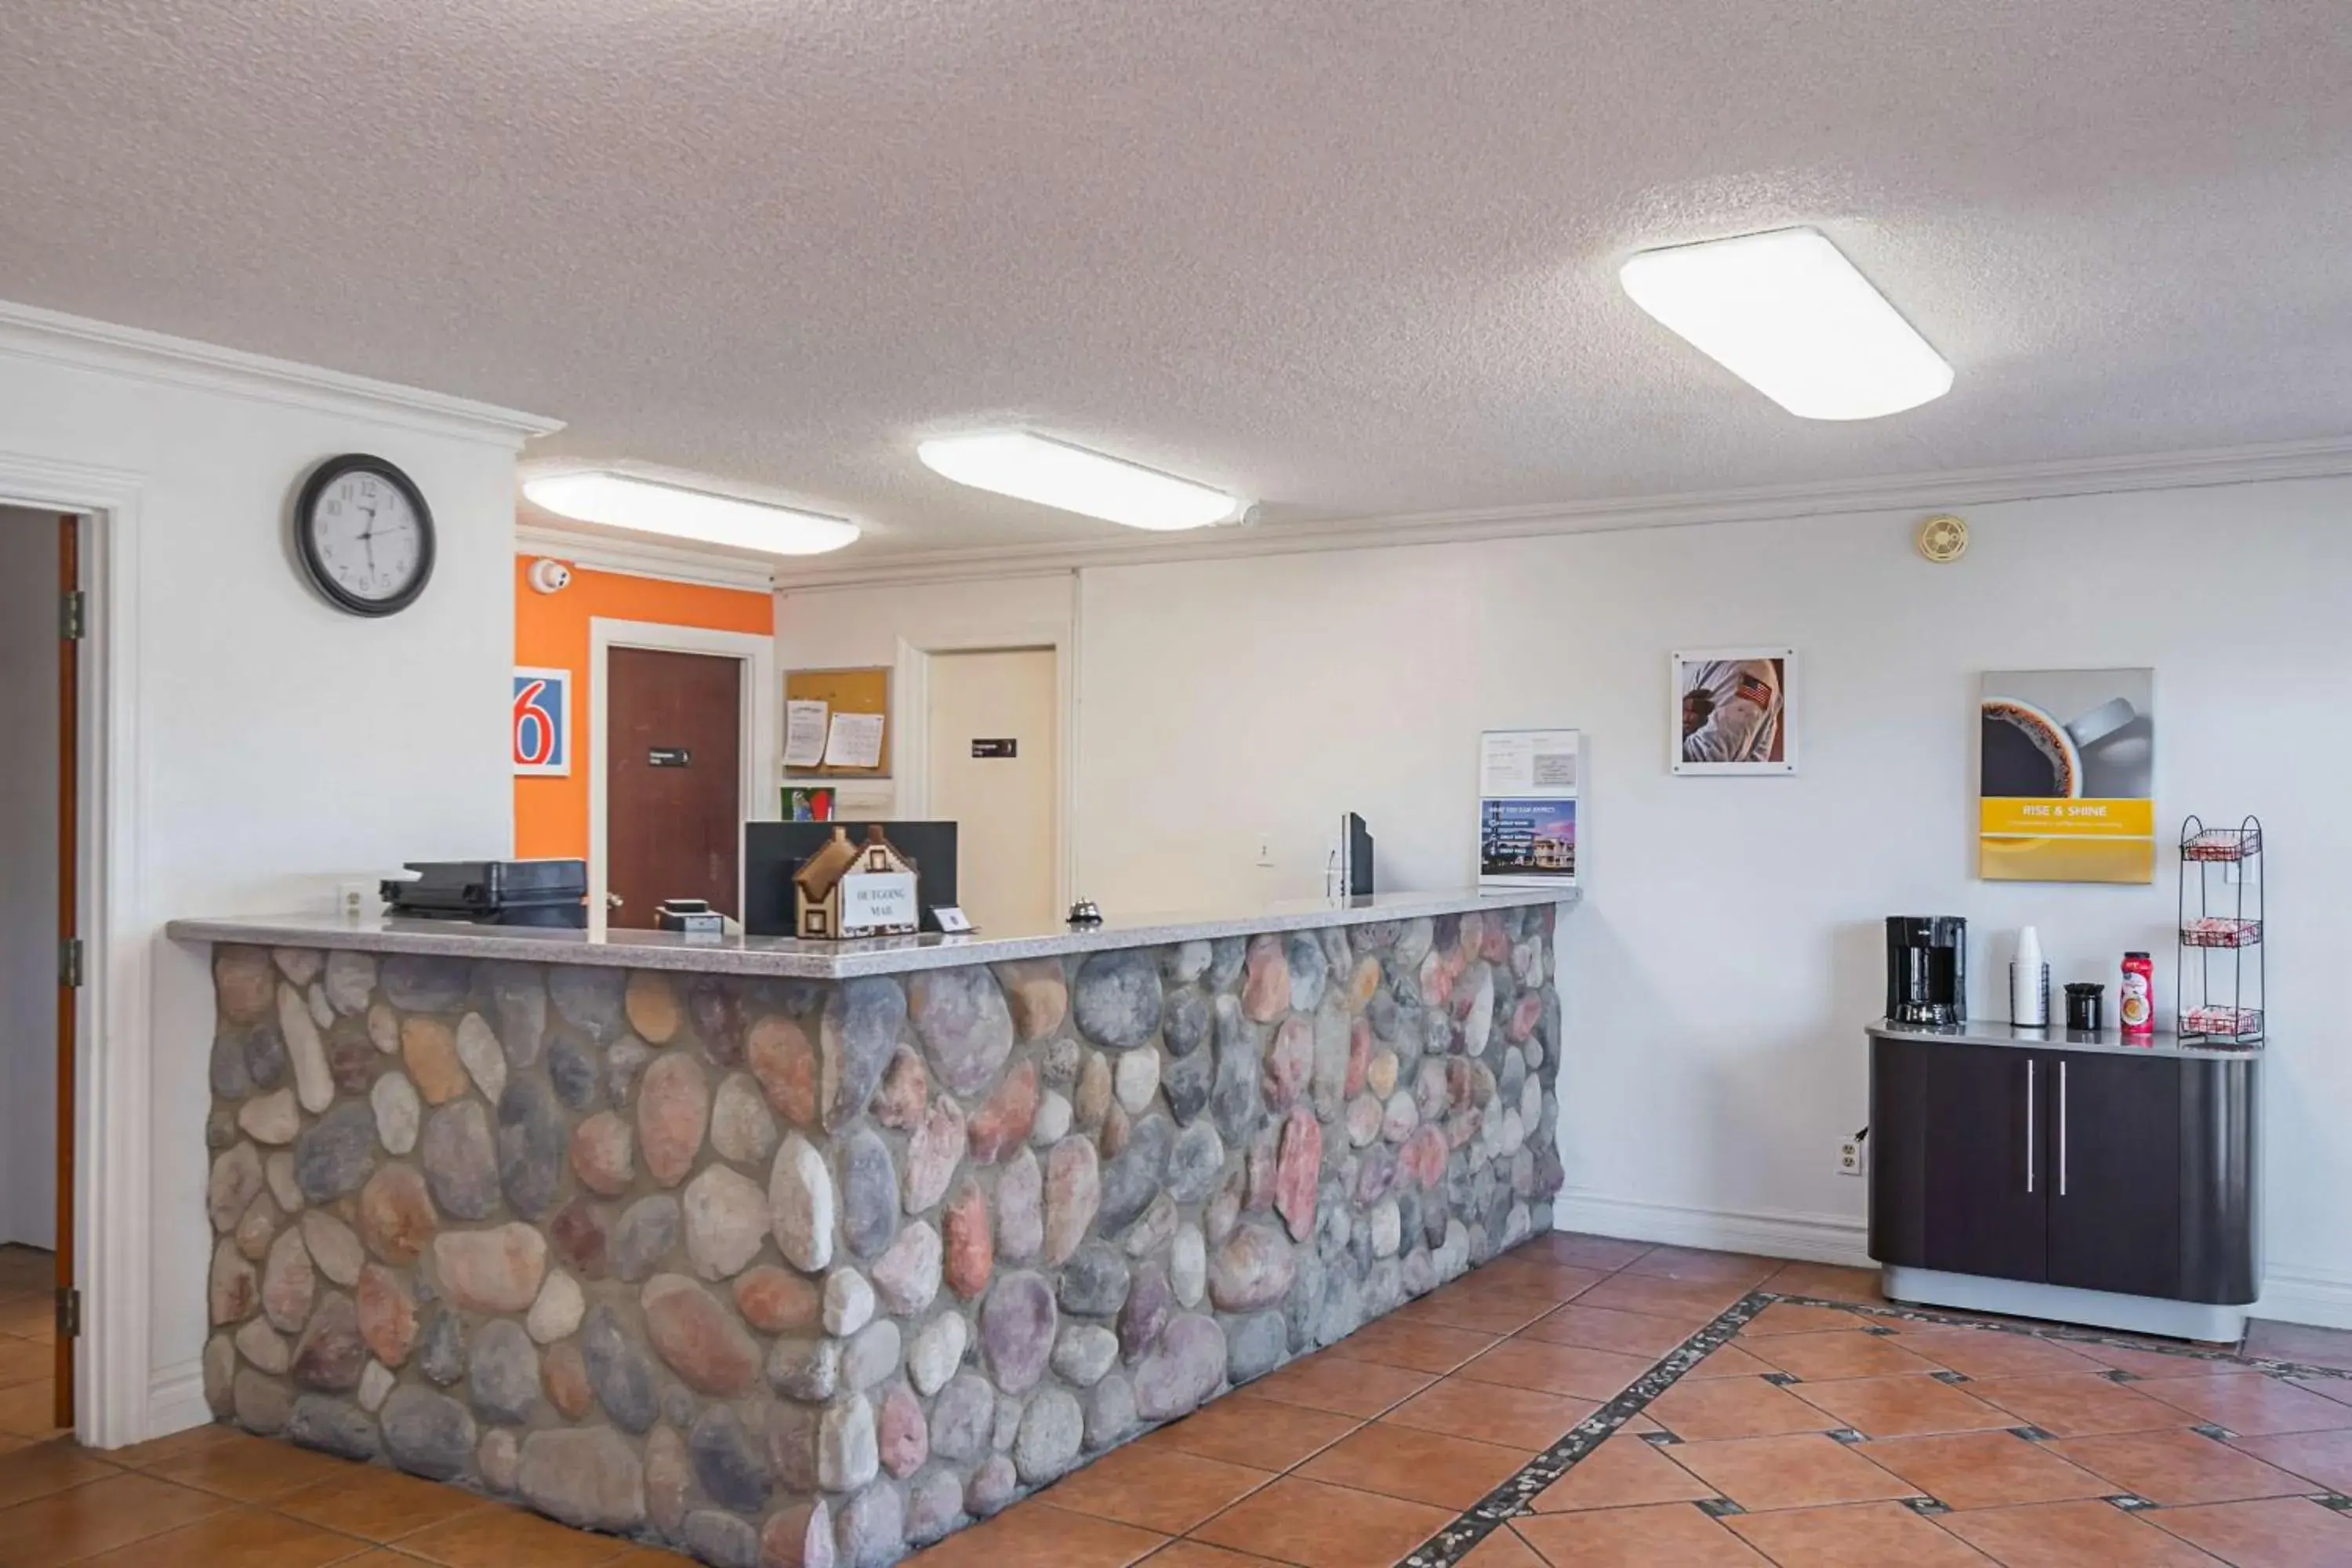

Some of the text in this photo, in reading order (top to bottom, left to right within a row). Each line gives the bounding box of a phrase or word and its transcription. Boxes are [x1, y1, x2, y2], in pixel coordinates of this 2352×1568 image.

[342, 484, 354, 502] 11
[361, 481, 376, 498] 12
[326, 499, 342, 516] 10
[387, 493, 394, 510] 1
[359, 576, 369, 592] 6
[382, 573, 391, 587] 5
[512, 680, 555, 765] 6
[2023, 805, 2107, 816] RISE & SHINE
[857, 887, 906, 901] OUTGOING
[870, 906, 894, 916] MAIL
